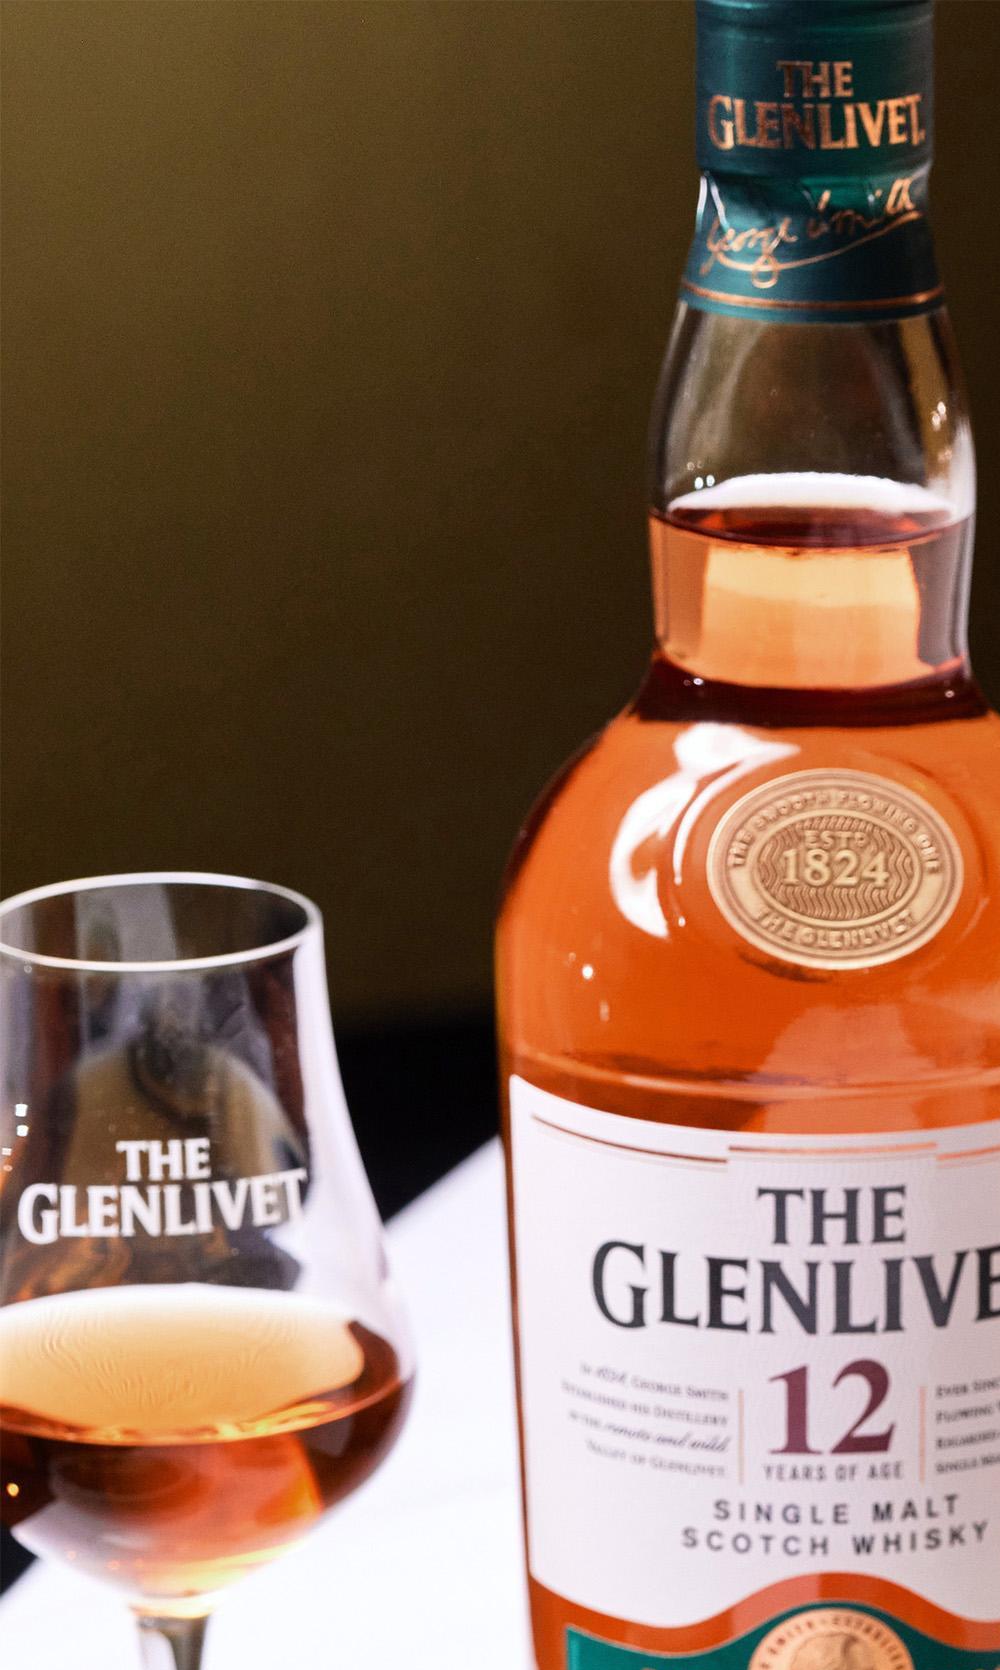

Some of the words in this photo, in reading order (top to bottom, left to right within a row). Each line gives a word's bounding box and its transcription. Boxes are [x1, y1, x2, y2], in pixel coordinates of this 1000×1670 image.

[777, 60, 853, 98] THE
[781, 848, 890, 888] 1824
[754, 909, 798, 941] THE
[801, 909, 915, 949] GLENLIVET
[115, 1137, 212, 1182] THE
[17, 1168, 308, 1245] GLENLIVET
[756, 1184, 907, 1246] THE
[768, 1358, 895, 1456] 12
[763, 1463, 827, 1483] YEARS
[835, 1463, 857, 1481] OF
[866, 1461, 904, 1480] AGE
[713, 1498, 850, 1526] SINGLE
[872, 1493, 960, 1523] MALT
[681, 1527, 830, 1557] SCOTCH
[852, 1520, 989, 1557] WHISKY
